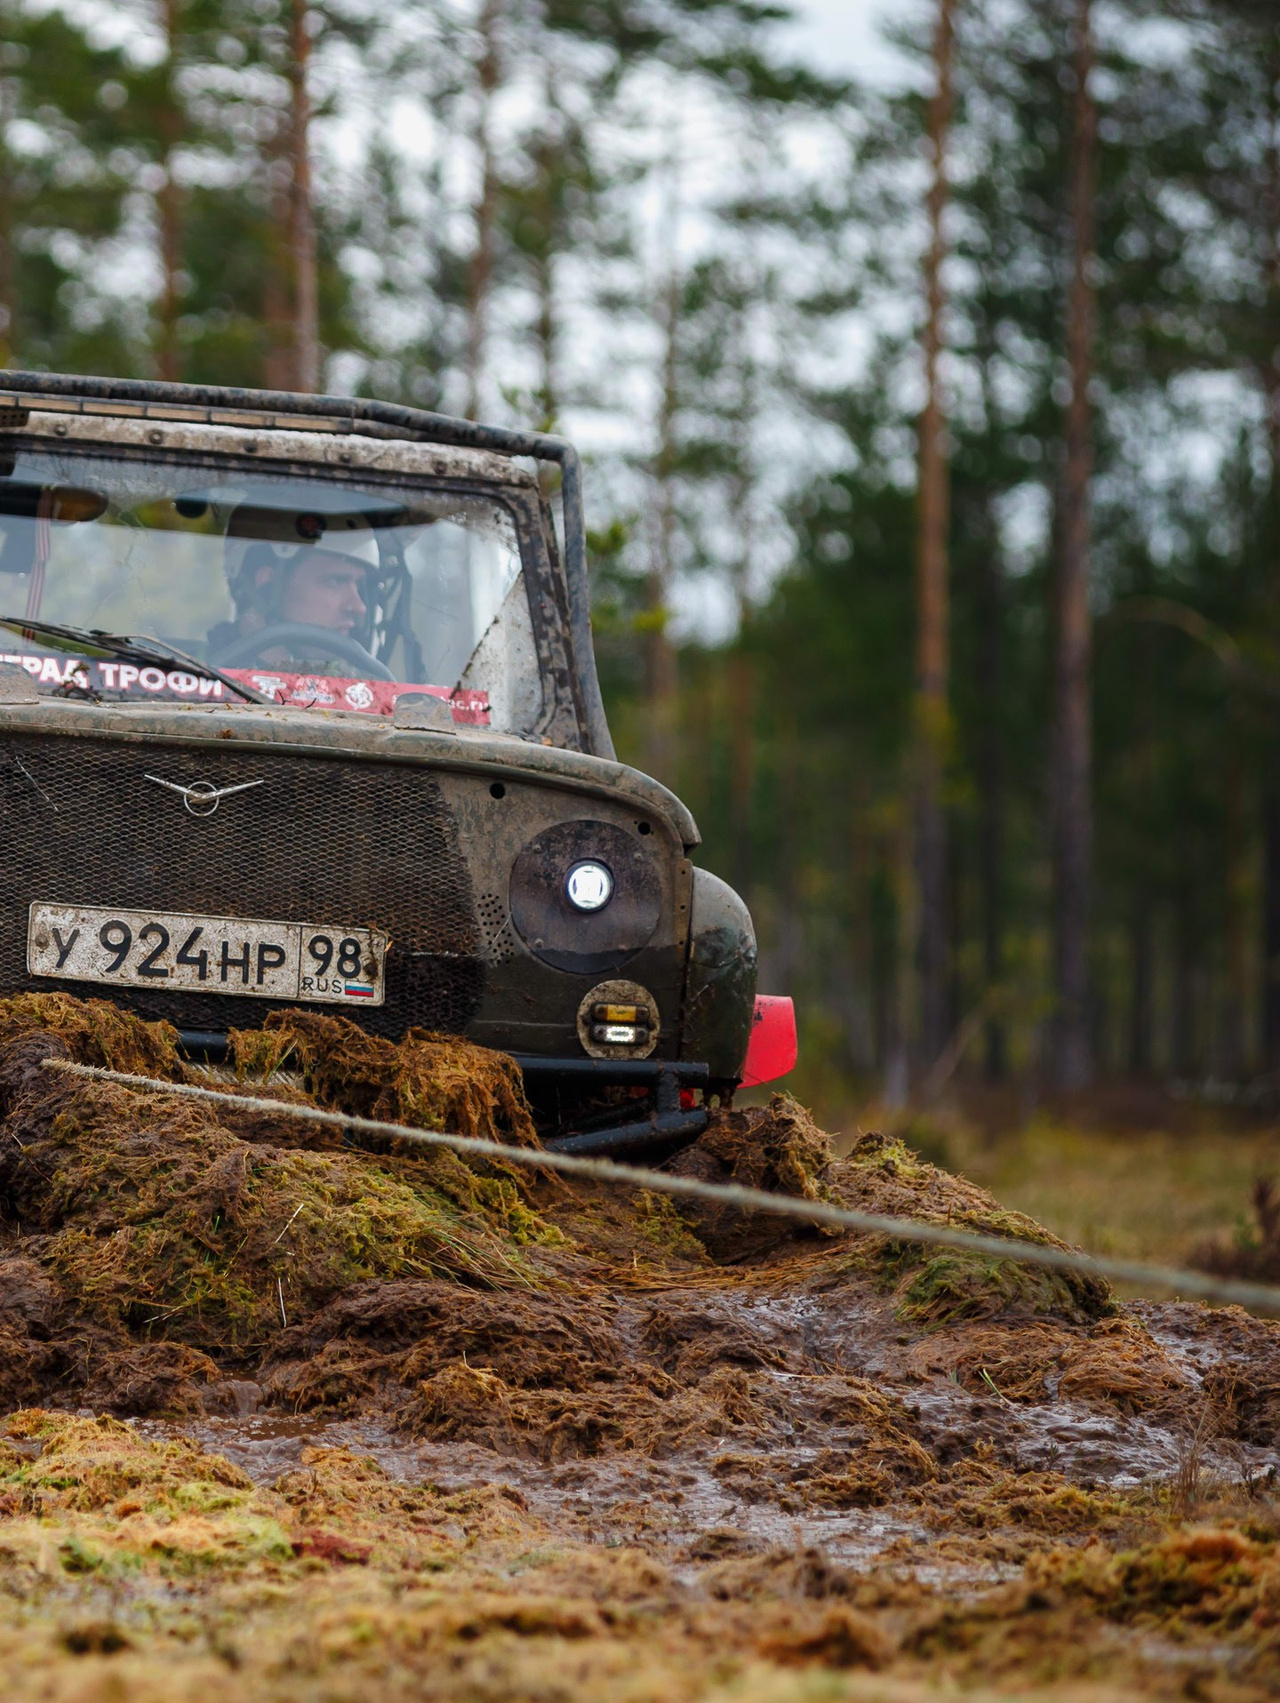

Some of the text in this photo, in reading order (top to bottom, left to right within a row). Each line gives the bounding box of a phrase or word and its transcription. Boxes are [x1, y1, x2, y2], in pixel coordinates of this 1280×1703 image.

[99, 662, 223, 697] ТРОФИ
[308, 934, 363, 979] 98
[301, 976, 344, 995] RUS
